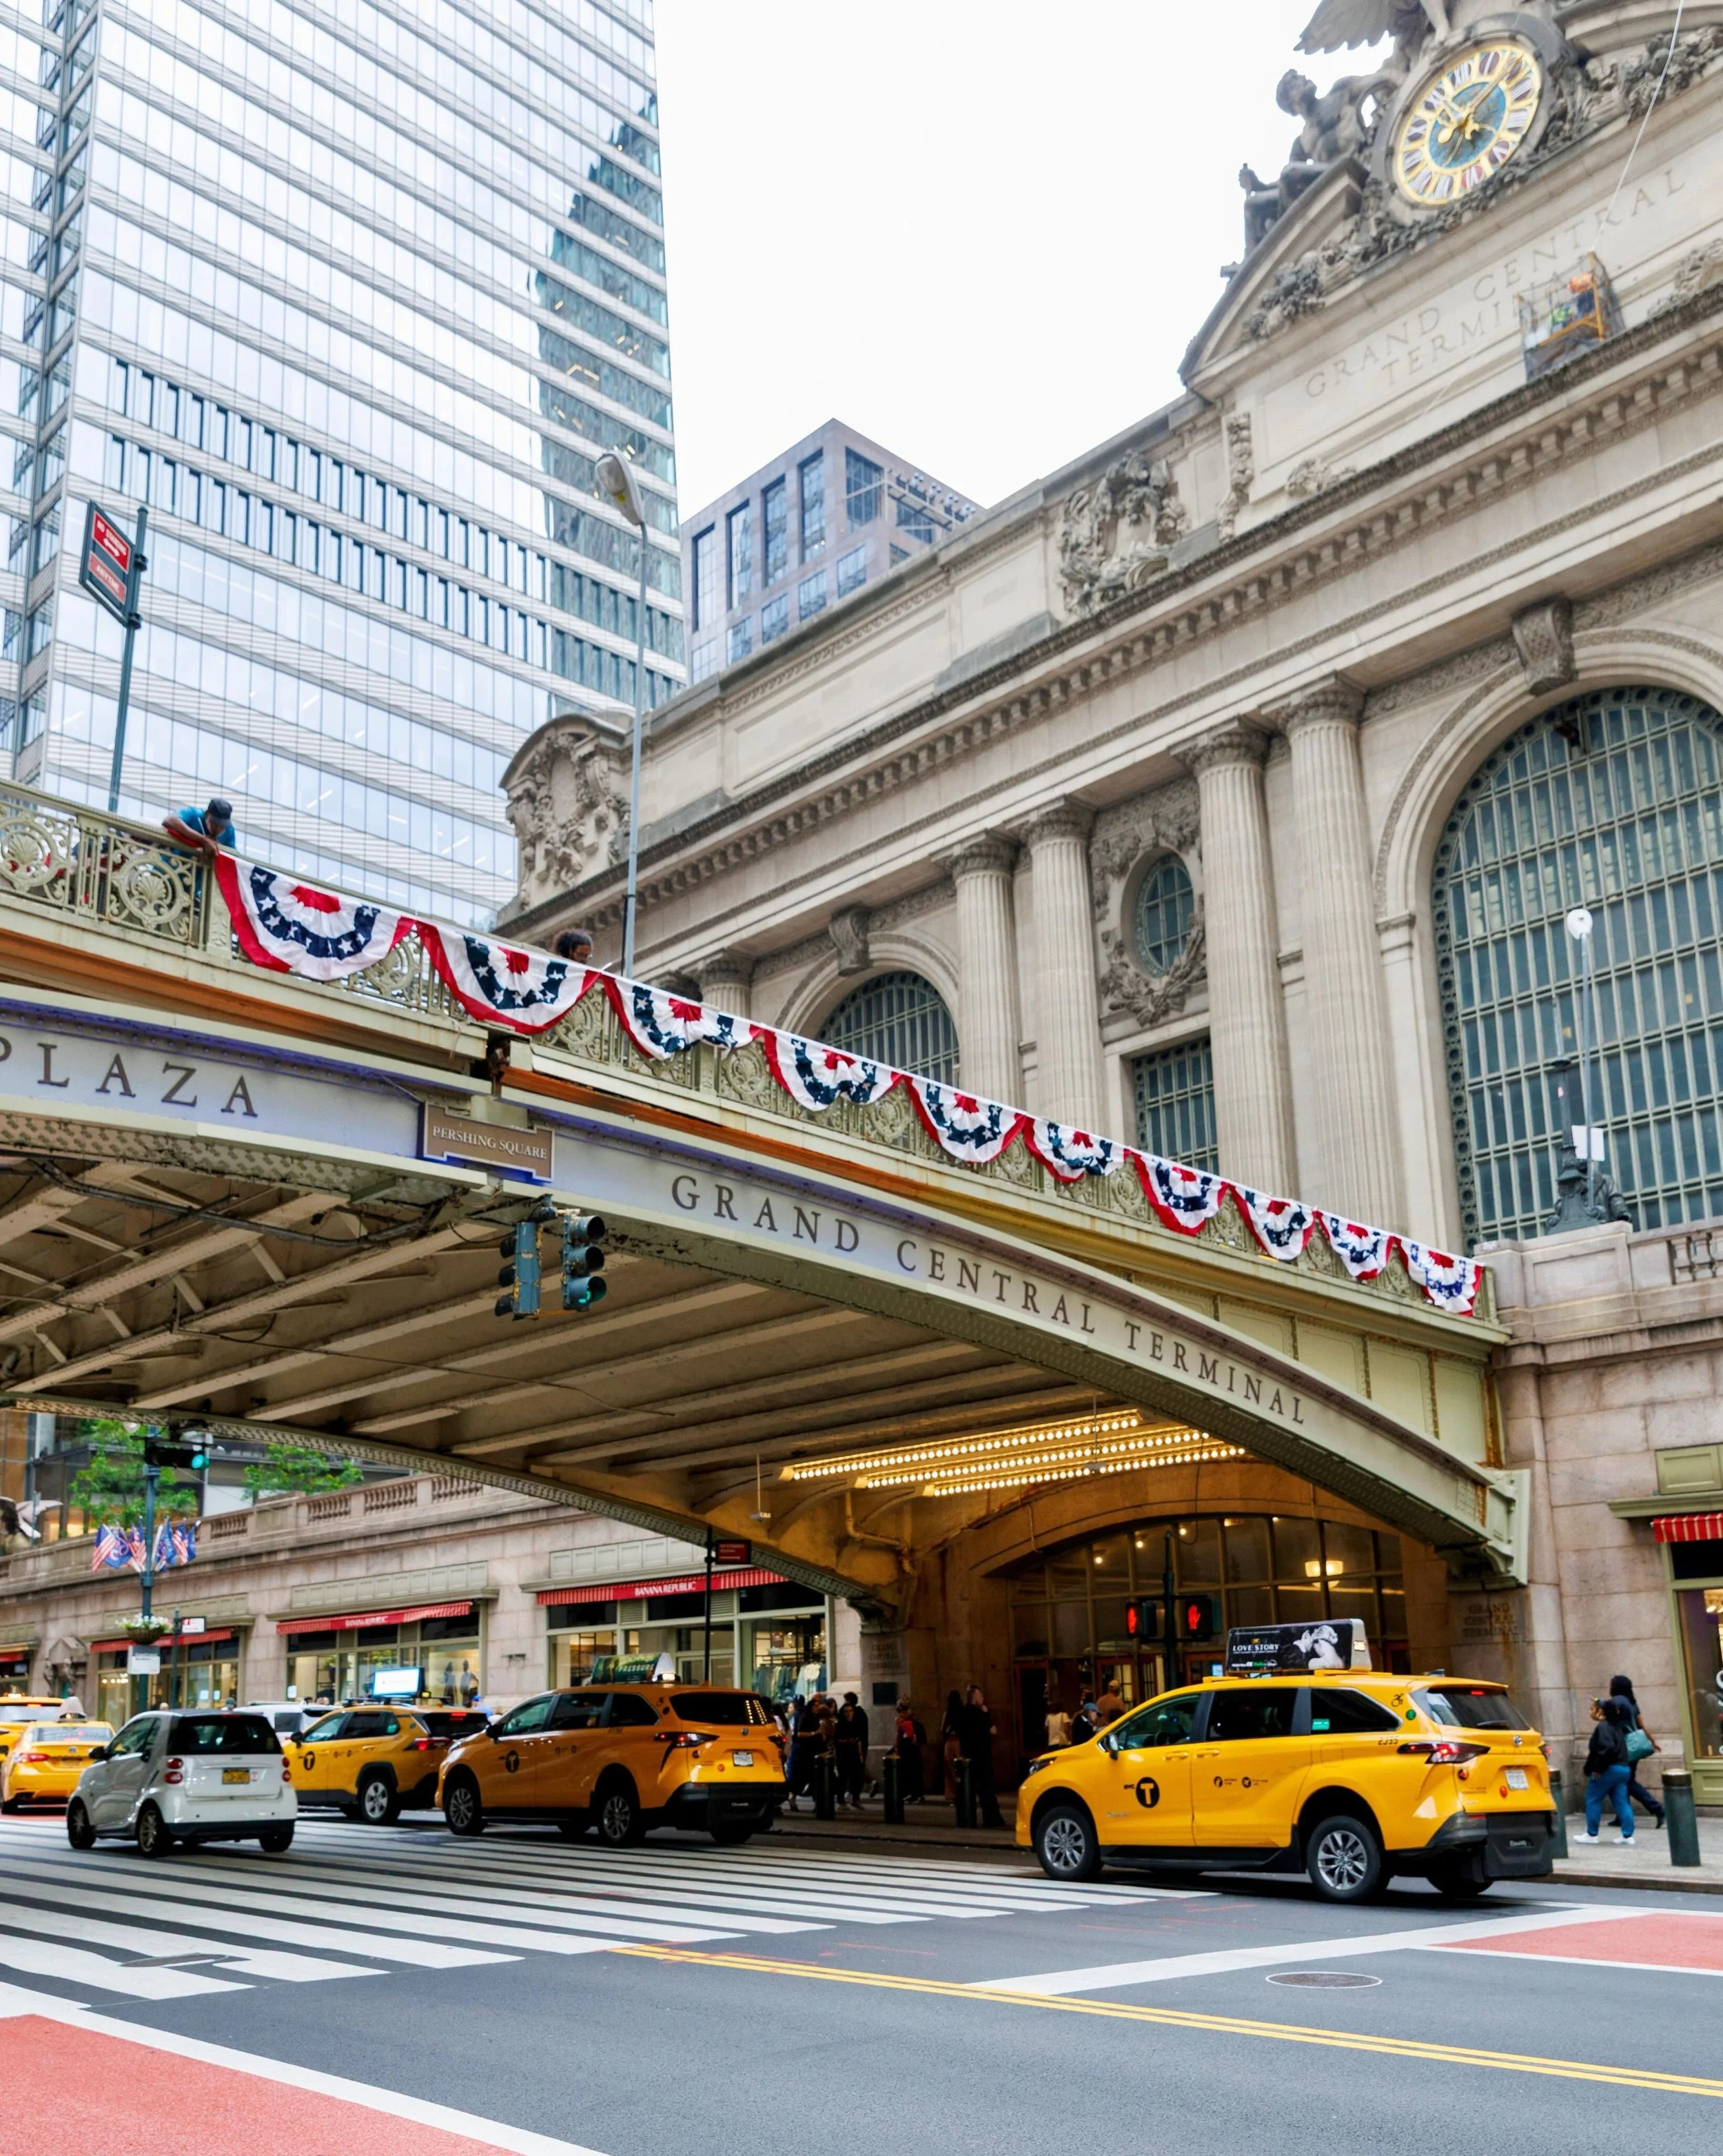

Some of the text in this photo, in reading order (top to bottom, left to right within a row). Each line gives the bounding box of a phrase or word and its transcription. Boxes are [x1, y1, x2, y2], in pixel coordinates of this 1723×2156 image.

[1305, 168, 1686, 398] GRAND CENTRAL
[1380, 292, 1521, 387] TERMI
[96, 520, 105, 533] NO
[432, 1125, 547, 1159] PERSHING SQUARE
[671, 1175, 1305, 1425] GRAND CENTRAL TERMINAL
[634, 1581, 697, 1596] BANANA REPUBLIC
